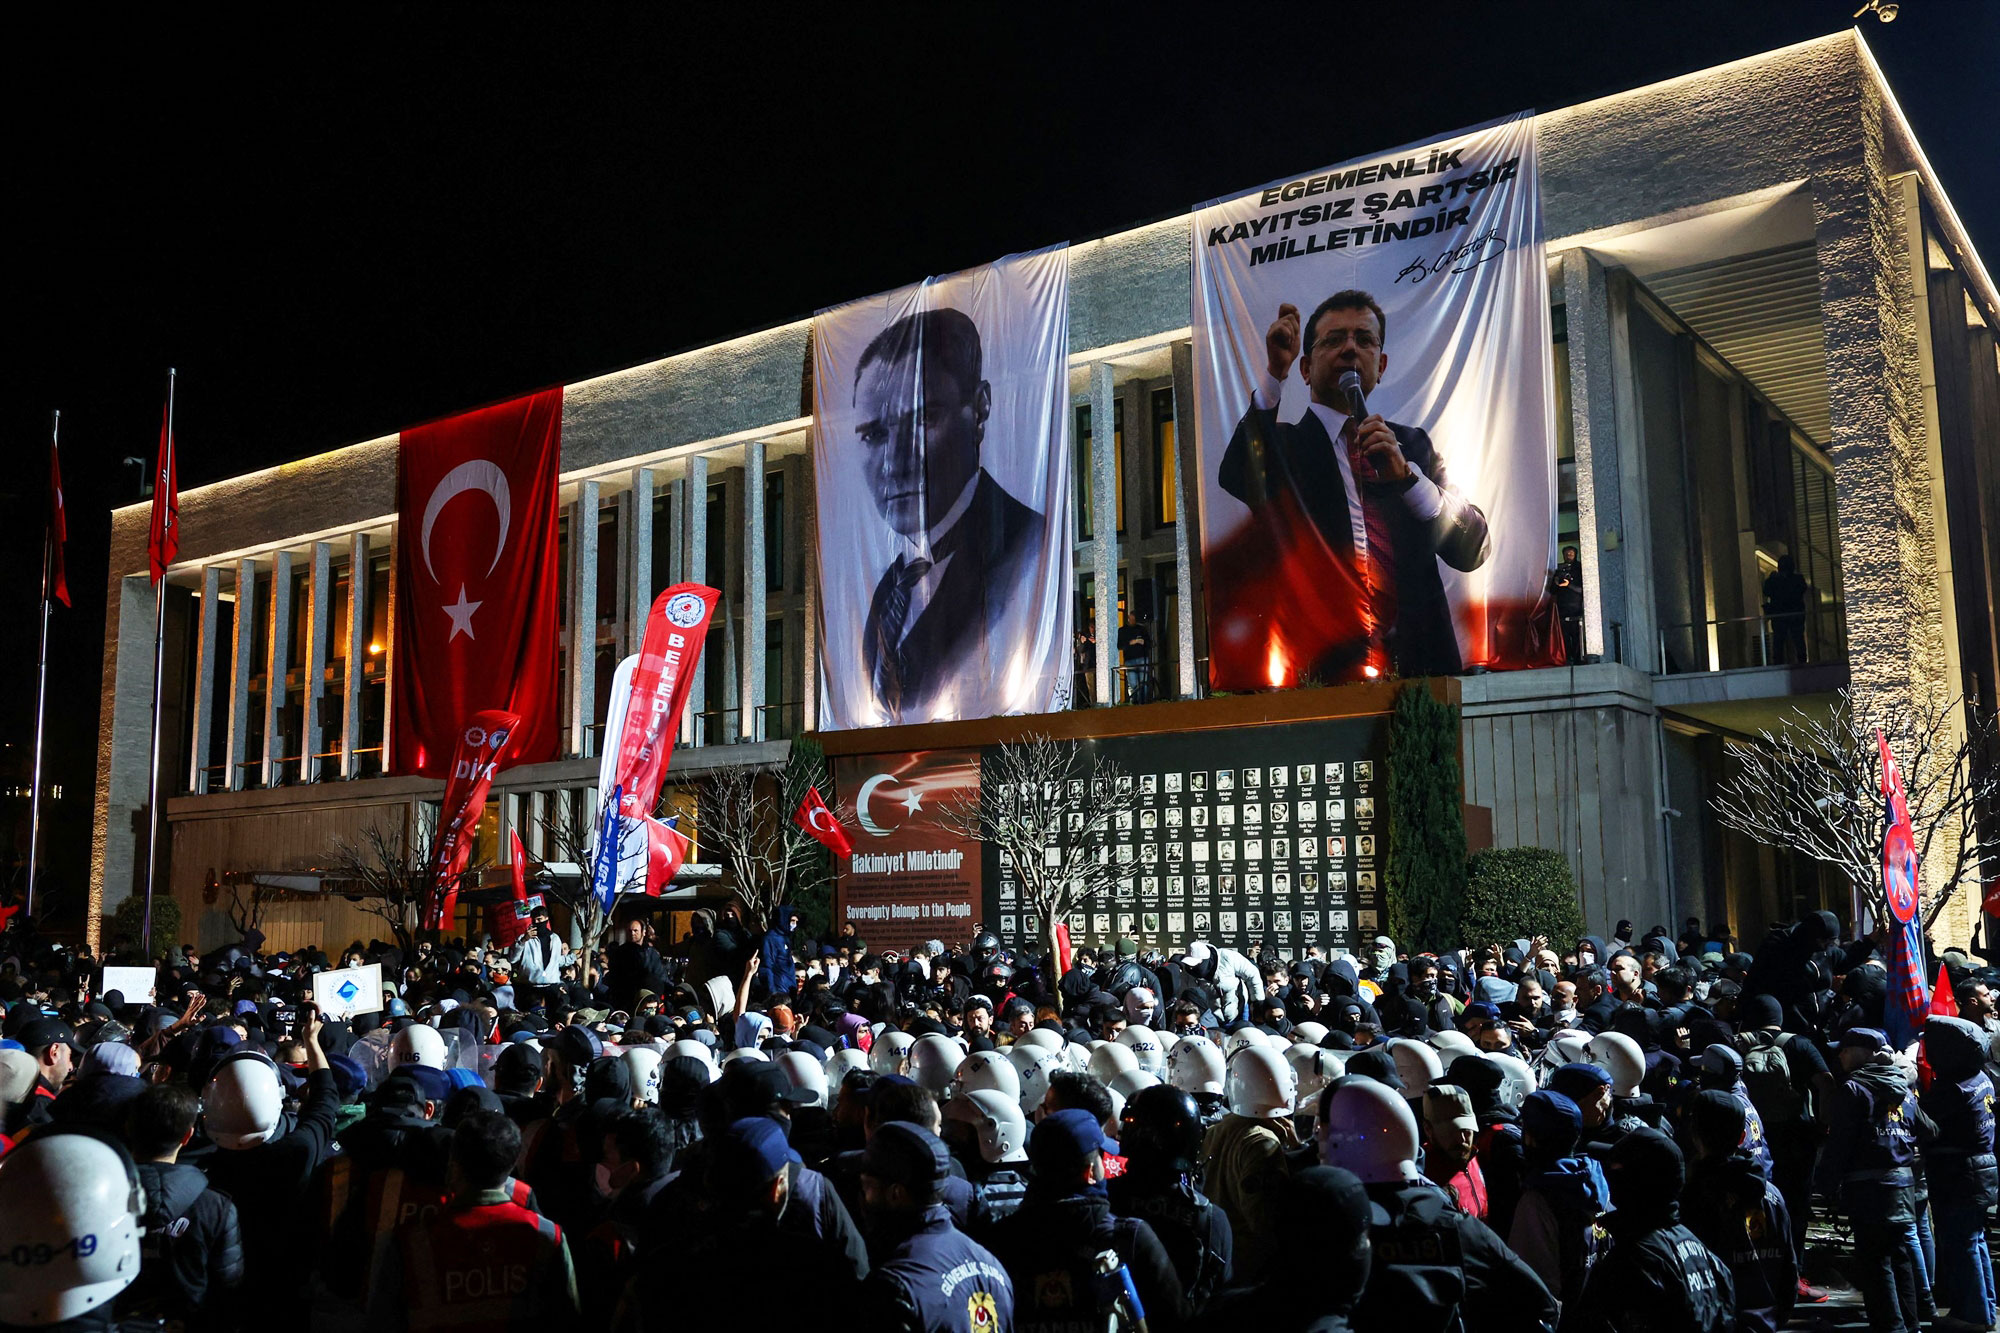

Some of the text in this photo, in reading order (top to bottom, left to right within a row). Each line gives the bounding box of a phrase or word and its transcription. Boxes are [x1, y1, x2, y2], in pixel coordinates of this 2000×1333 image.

[1260, 148, 1464, 207] EGEMENLİK
[1207, 156, 1520, 247] KAYITSIZ ŞARTSIZ
[1249, 204, 1471, 267] MİLLETİNDİR
[852, 849, 964, 875] Hakimiyet Milletindir
[846, 902, 971, 921] Sovereignty Belongs to the People
[1130, 1042, 1155, 1053] 1522
